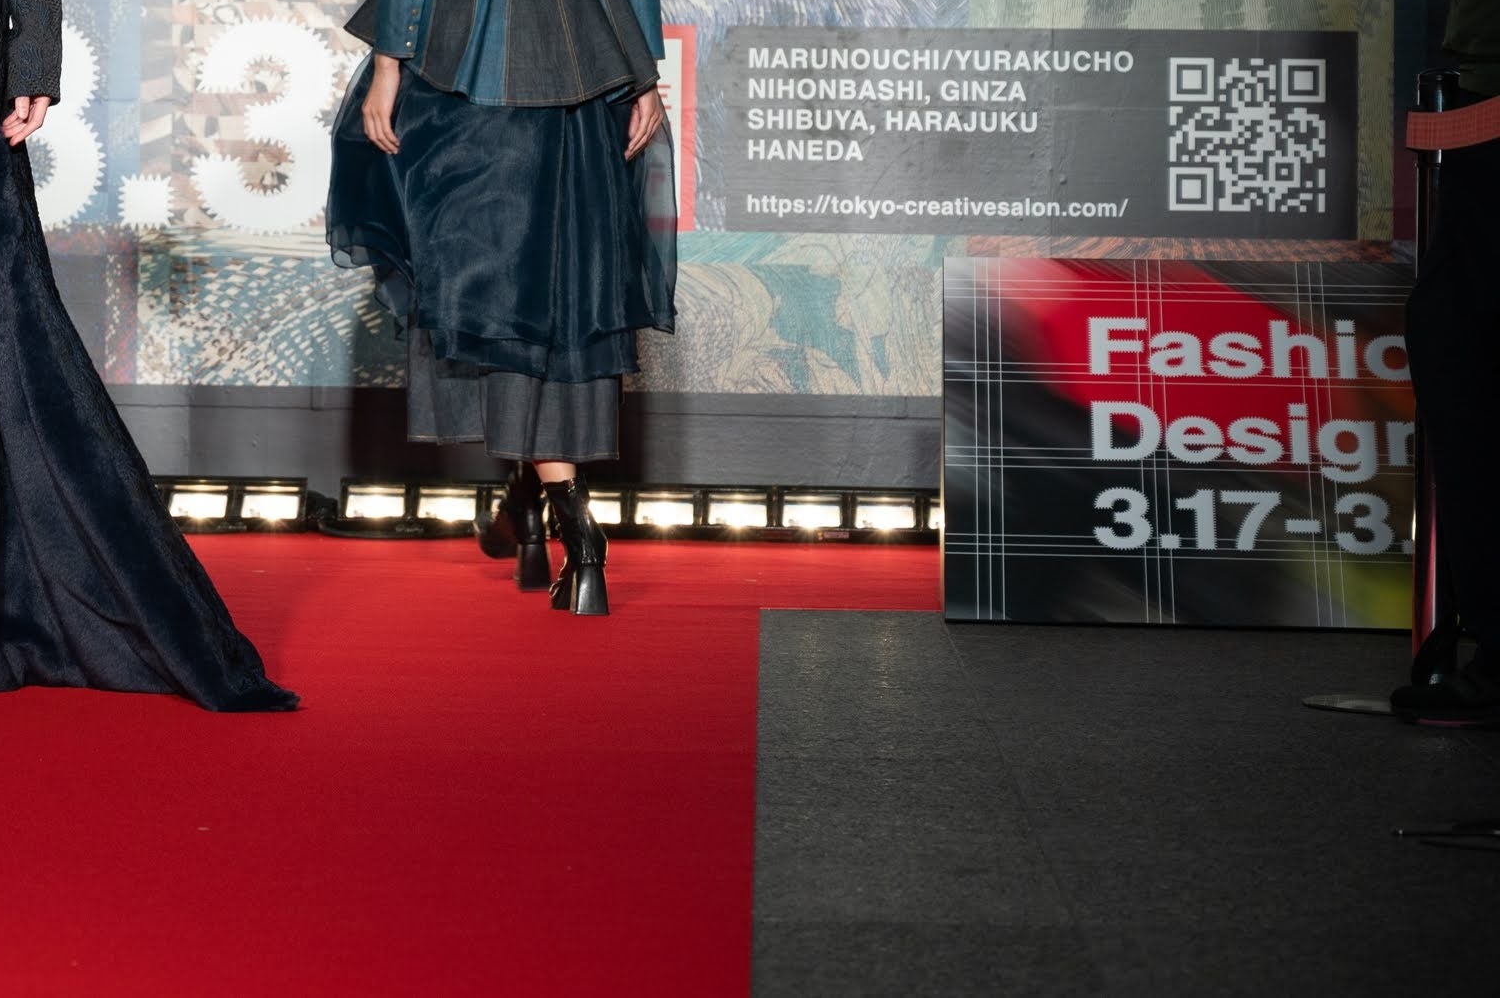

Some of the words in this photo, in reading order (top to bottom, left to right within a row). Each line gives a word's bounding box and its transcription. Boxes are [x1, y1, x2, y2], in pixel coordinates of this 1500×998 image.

[747, 47, 1135, 73] MARUNOUCHI/YURAKUCHO
[747, 78, 931, 105] NIHONBASHI,
[939, 80, 1027, 102] GINZA
[746, 109, 876, 135] SHIBUYA,
[885, 111, 1039, 133] HARAJUKU
[747, 139, 864, 162] HANEDA
[746, 194, 1129, 219] https://tokyo-creativesalon.com/
